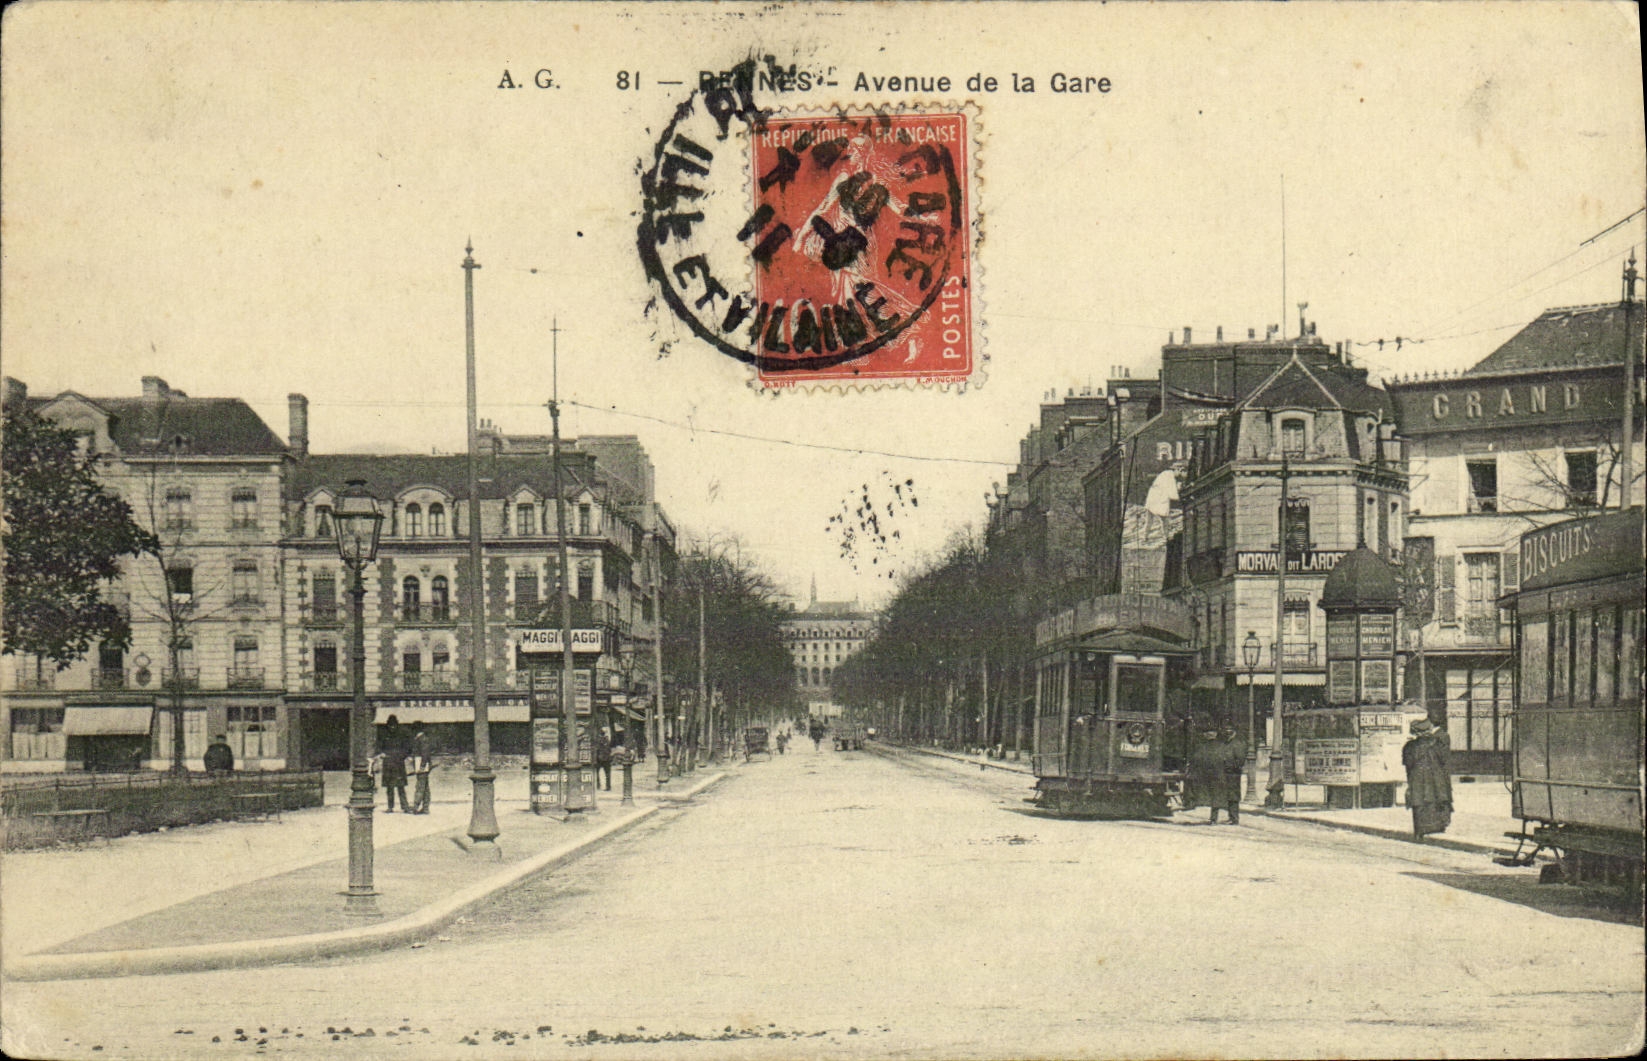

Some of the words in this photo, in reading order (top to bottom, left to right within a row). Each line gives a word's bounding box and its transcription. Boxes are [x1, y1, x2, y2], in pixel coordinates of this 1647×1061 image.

[943, 275, 960, 359] POSTES
[1433, 383, 1581, 420] GRAND
[1238, 552, 1281, 571] MORVA
[1287, 560, 1301, 571] DIT
[1523, 523, 1590, 583] BISCUITS
[522, 631, 558, 644] MAGGI
[562, 631, 599, 644] AGGI
